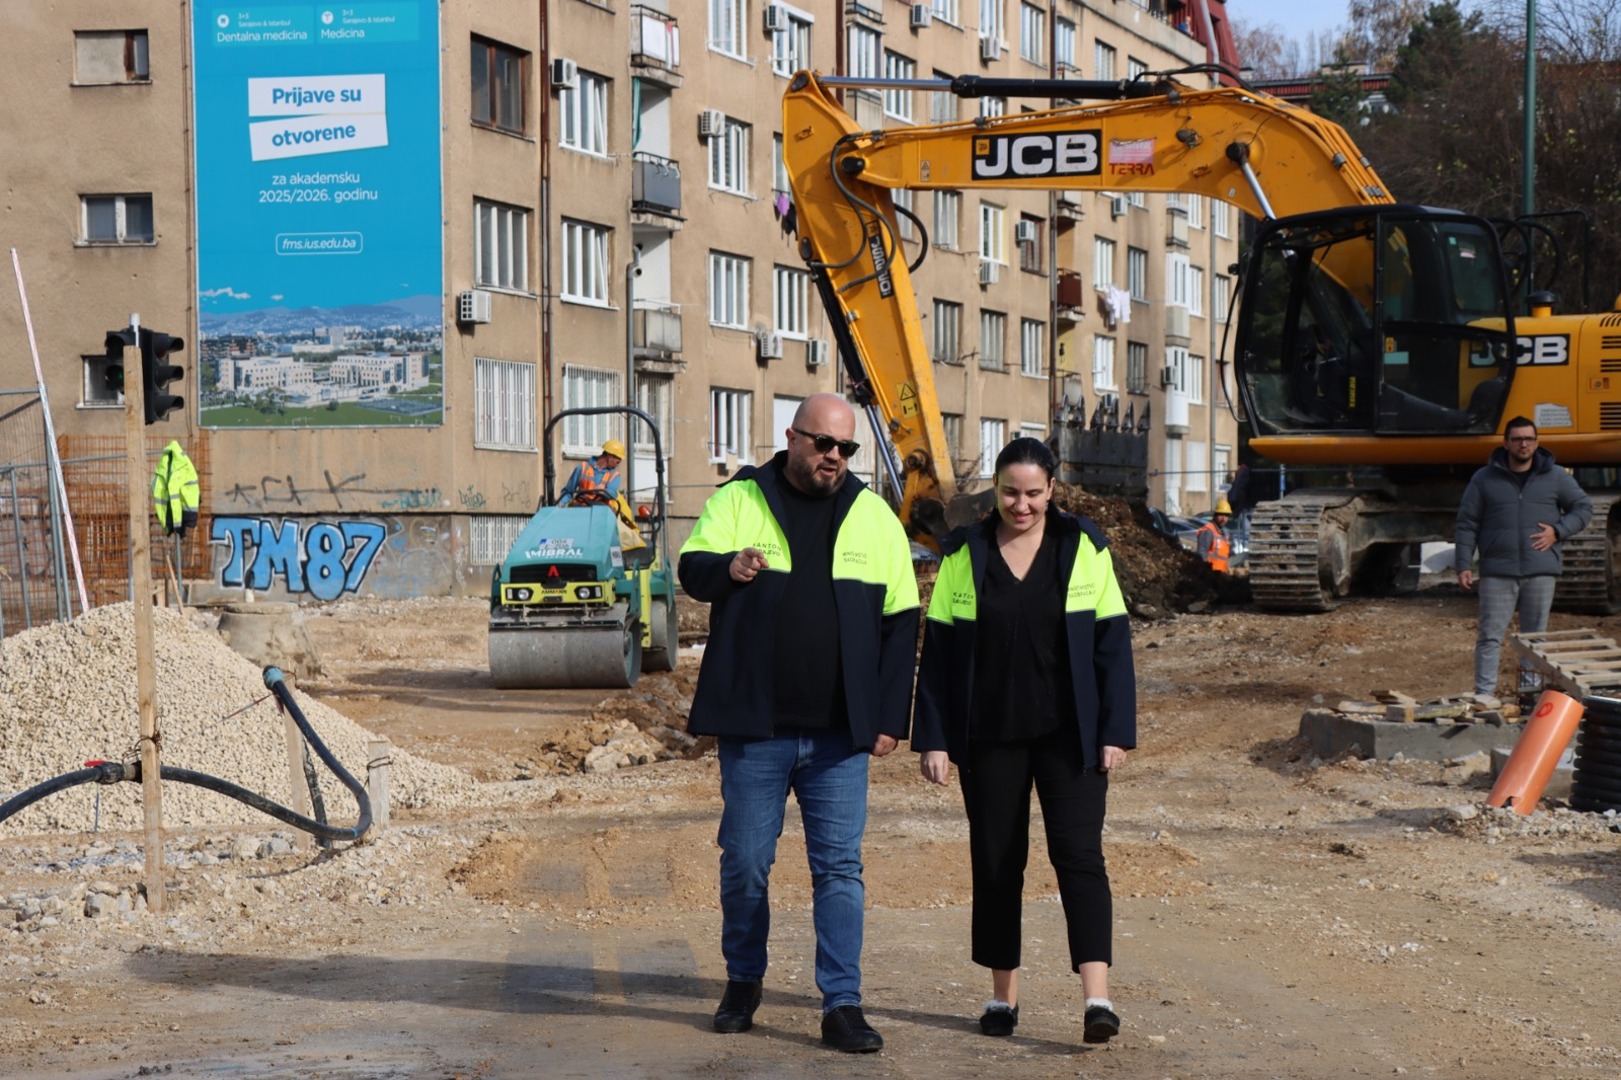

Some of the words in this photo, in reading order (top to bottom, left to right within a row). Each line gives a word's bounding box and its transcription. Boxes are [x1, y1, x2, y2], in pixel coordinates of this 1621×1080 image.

[216, 30, 261, 42] Dentalna
[262, 29, 308, 41] medicina
[320, 28, 366, 39] Medicina
[272, 86, 336, 107] Prijave
[340, 88, 362, 103] su
[271, 124, 356, 147] otvorene
[975, 133, 1098, 177] JCB
[1108, 162, 1155, 176] TERRA
[272, 174, 287, 186] za
[289, 171, 360, 185] akademsku
[258, 188, 332, 204] 2025/2026.
[334, 187, 378, 203] godinu
[282, 237, 357, 251] fms.ius.edu.ba
[211, 516, 386, 601] TM87
